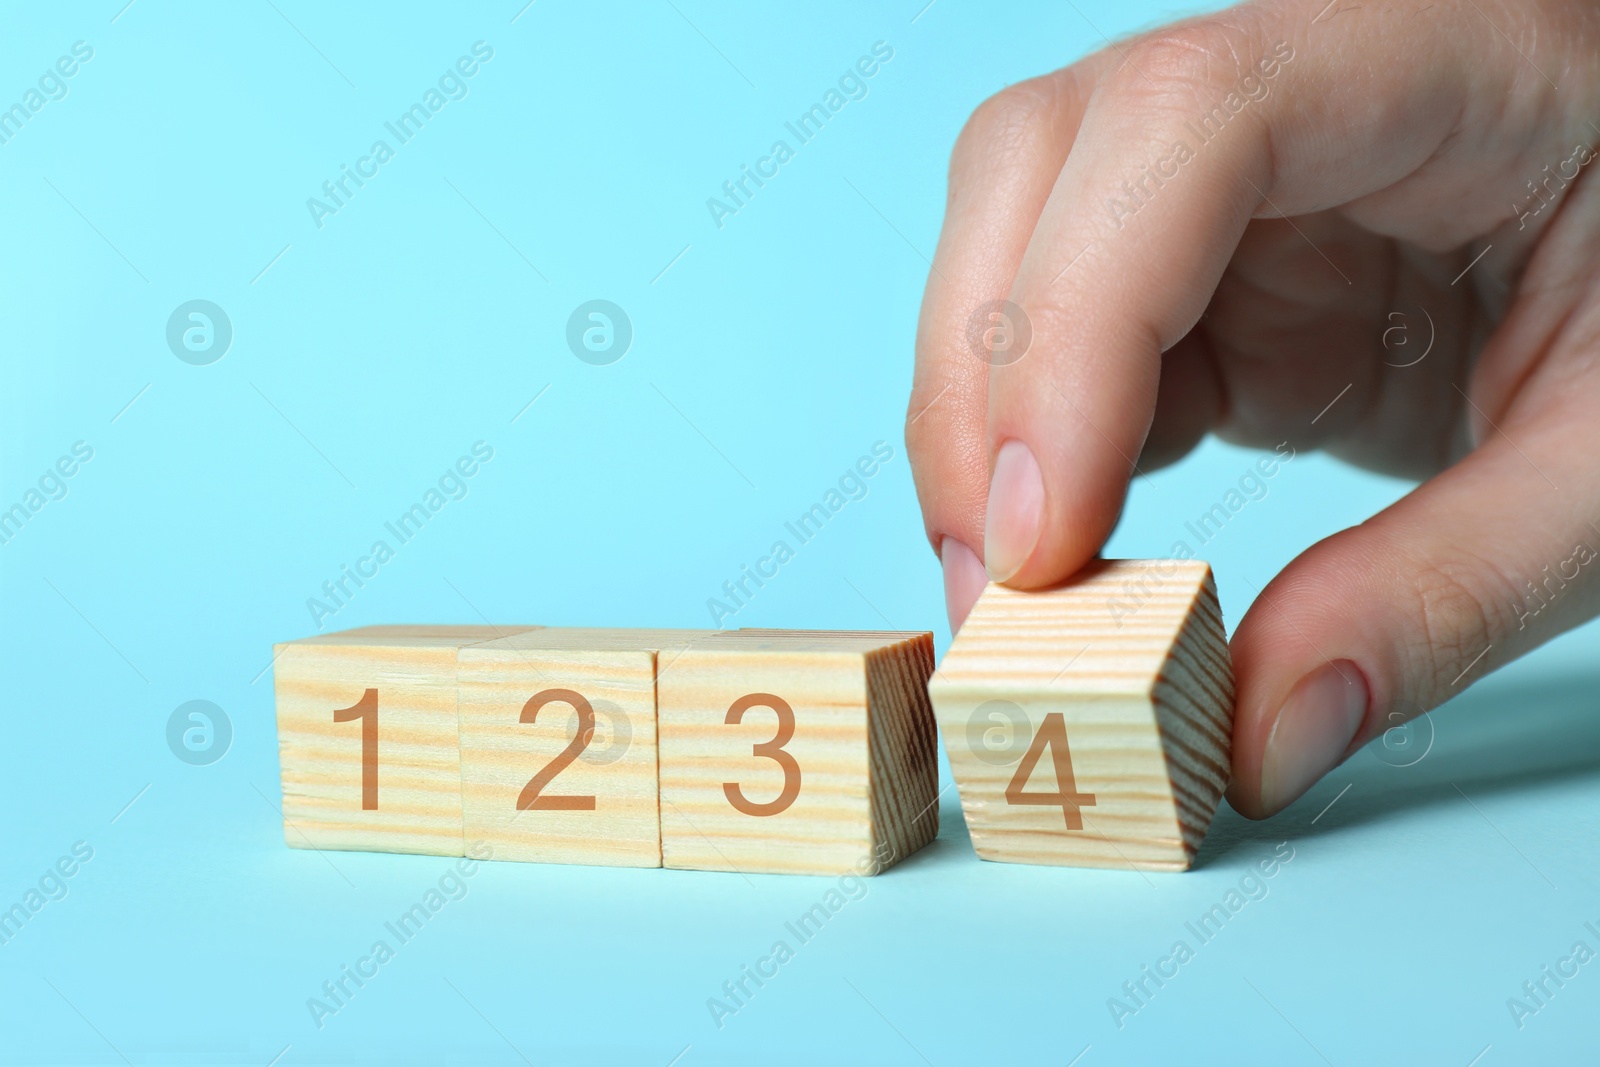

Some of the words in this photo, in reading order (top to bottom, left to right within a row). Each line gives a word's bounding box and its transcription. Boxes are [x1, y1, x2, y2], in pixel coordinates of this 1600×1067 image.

[333, 688, 379, 811] 1
[515, 688, 596, 811] 2
[722, 692, 801, 818] 3
[1004, 712, 1097, 831] 4
